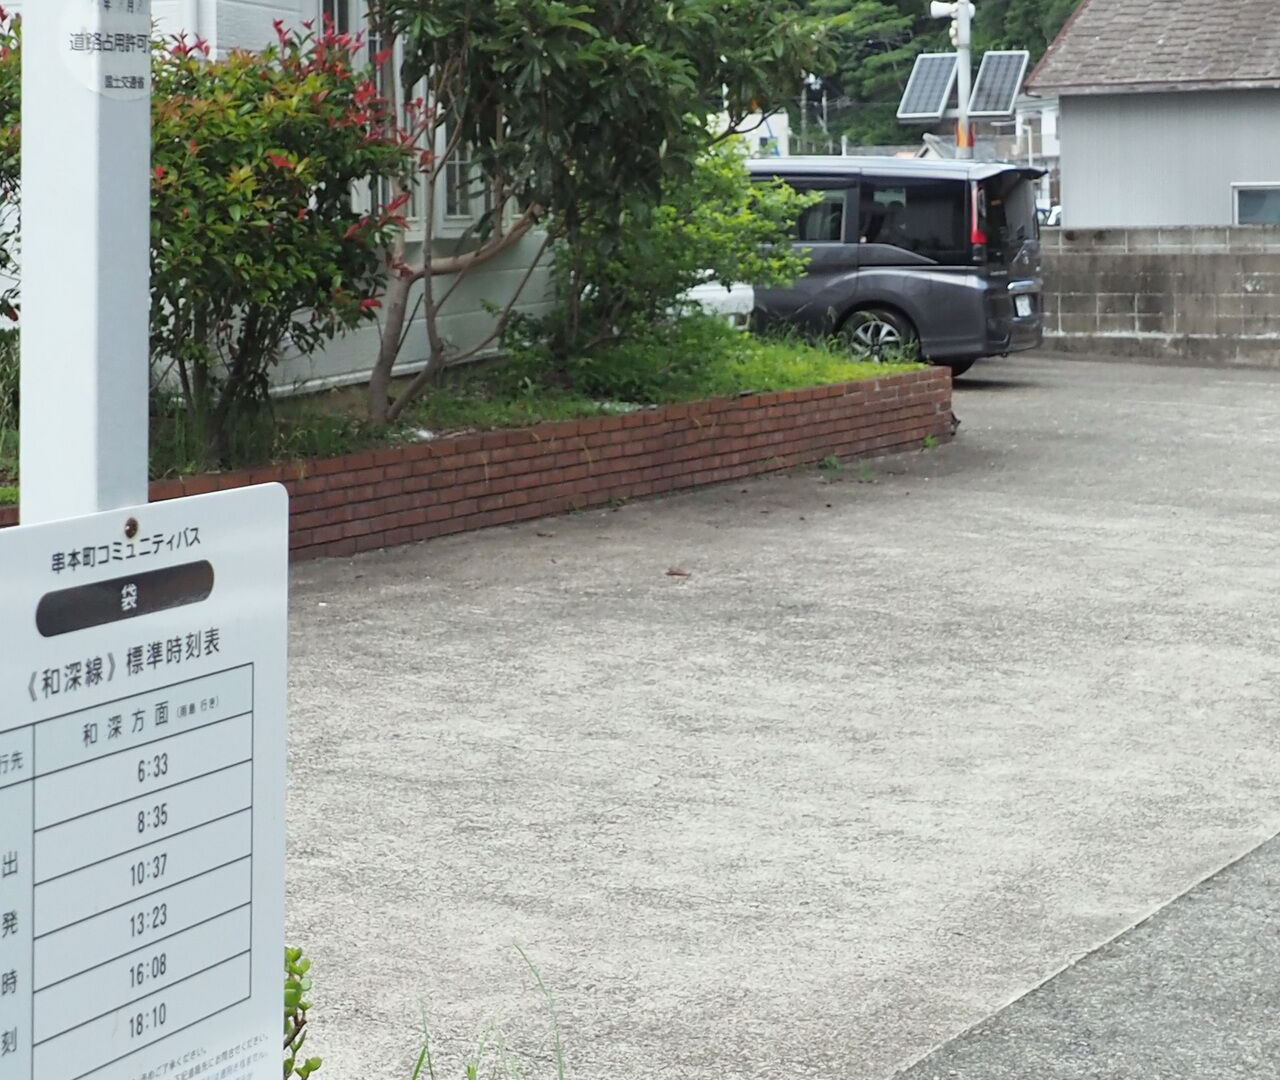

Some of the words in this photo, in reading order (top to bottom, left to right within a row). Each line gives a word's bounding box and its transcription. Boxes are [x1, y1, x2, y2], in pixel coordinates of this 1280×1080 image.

[70, 32, 151, 54] 道路占用許可
[52, 527, 201, 574] 串本町コミュニティバス
[121, 583, 138, 611] 袋
[137, 752, 168, 783] 6:33
[137, 802, 168, 834] 8:35
[130, 852, 168, 887] 10:37
[130, 903, 167, 937] 13:23
[129, 953, 167, 988] 16:08
[129, 1002, 167, 1038] 18:10
